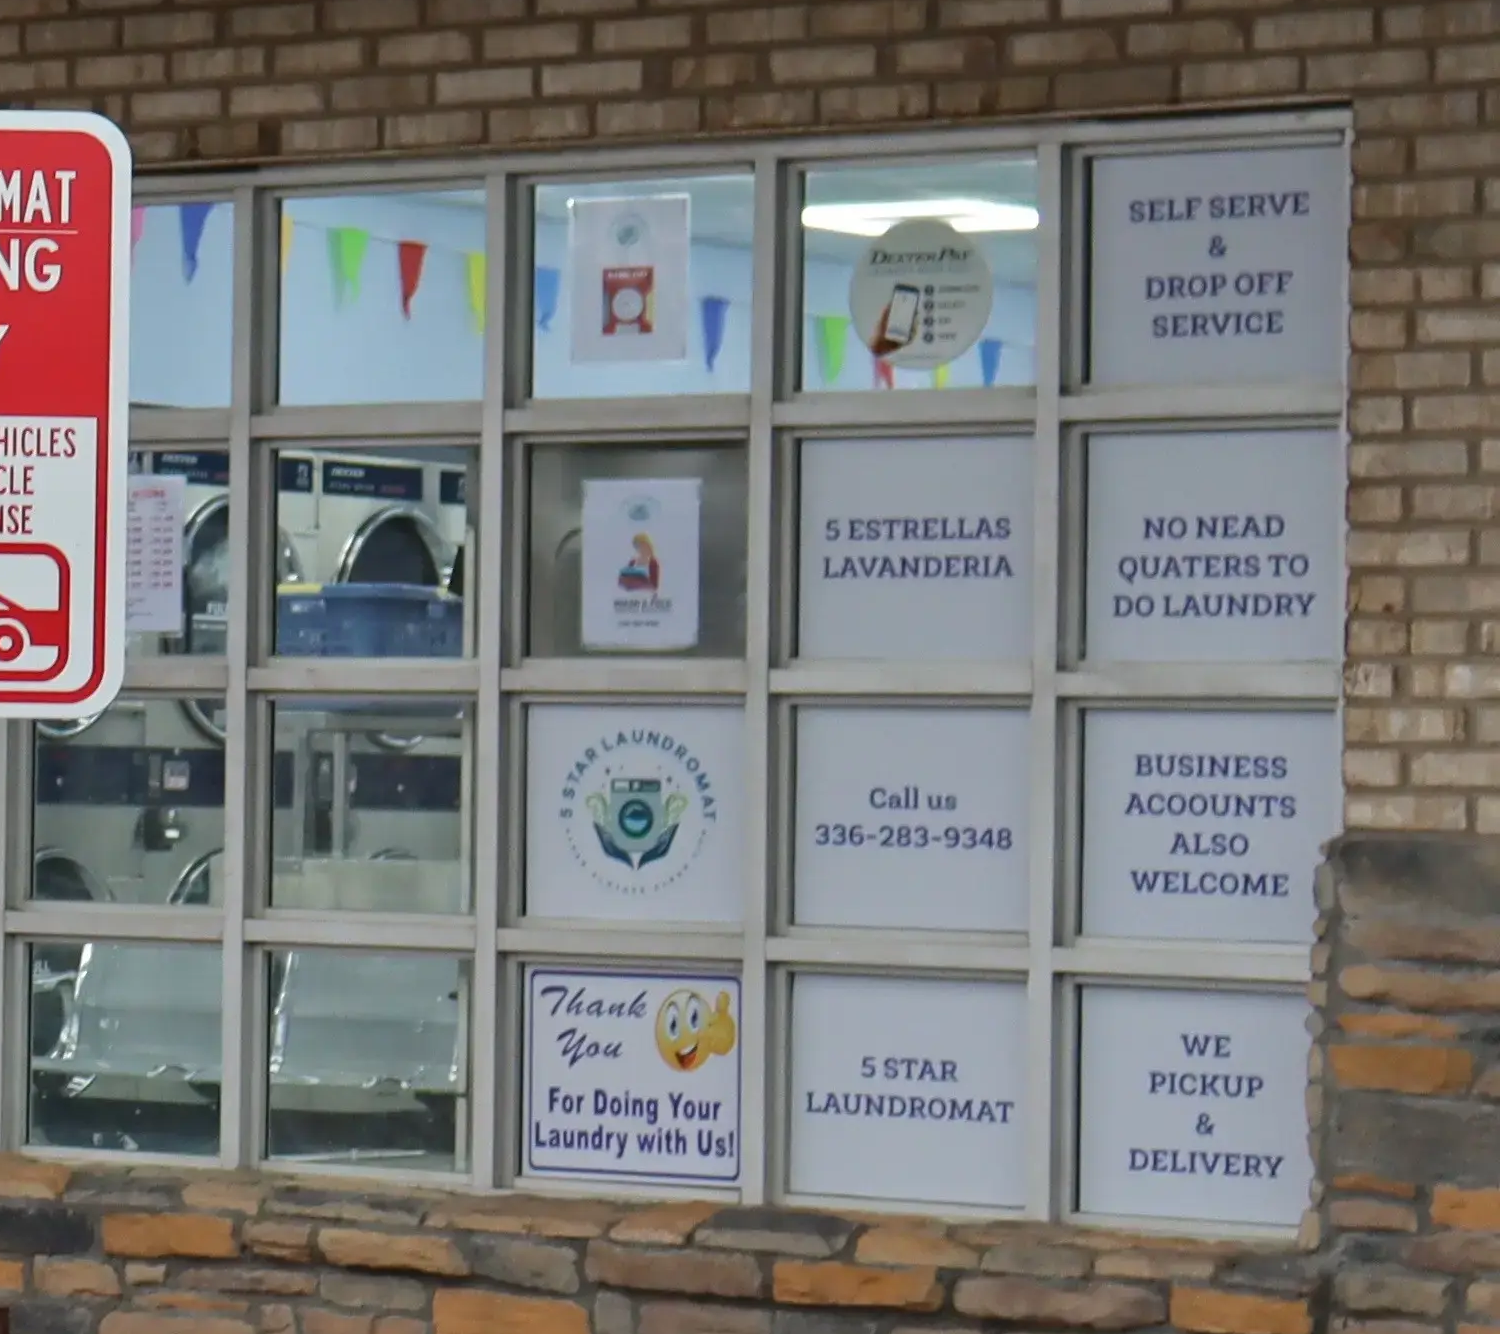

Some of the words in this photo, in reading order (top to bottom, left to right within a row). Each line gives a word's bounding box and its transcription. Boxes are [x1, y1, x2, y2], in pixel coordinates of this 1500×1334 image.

[1129, 197, 1202, 222] SELF
[1209, 191, 1310, 219] SERVE
[1208, 235, 1227, 257] &
[1145, 273, 1227, 300] DROP
[1234, 270, 1293, 296] OFF
[1152, 310, 1284, 338] SERVICE
[826, 520, 841, 541] 5
[849, 517, 1012, 541] ESTRELLAS
[1143, 516, 1187, 540] NO
[1196, 514, 1285, 539] NEAD
[823, 554, 1014, 579] LAVANDERIA
[1118, 555, 1261, 585] QUATERS
[1268, 554, 1310, 578] TO
[1113, 595, 1155, 617] DO
[1163, 593, 1317, 617] LAUNDRY
[562, 747, 599, 800] STAR
[600, 729, 717, 823] LAUNDROMAT
[1135, 754, 1288, 779] BUSINESS
[869, 785, 919, 810] Call
[927, 794, 957, 811] us
[560, 808, 573, 818] 5
[815, 823, 1013, 851] 336-283-9348
[1170, 832, 1249, 856] ALSO
[1131, 870, 1289, 897] WELCOME
[540, 985, 648, 1018] Thank
[557, 1028, 624, 1068] You
[1181, 1033, 1231, 1058] WE
[861, 1057, 876, 1078] 5
[884, 1057, 958, 1082] STAR
[1149, 1071, 1264, 1098] PICKUP
[549, 1086, 584, 1114] For
[594, 1089, 659, 1124] Doing
[669, 1092, 721, 1121] Your
[806, 1091, 1014, 1124] LAUNDROMAT
[1195, 1112, 1215, 1136] &
[535, 1121, 628, 1159] Laundry
[637, 1127, 687, 1155] with
[697, 1129, 735, 1158] Us!
[1128, 1148, 1284, 1179] DELIVERY
